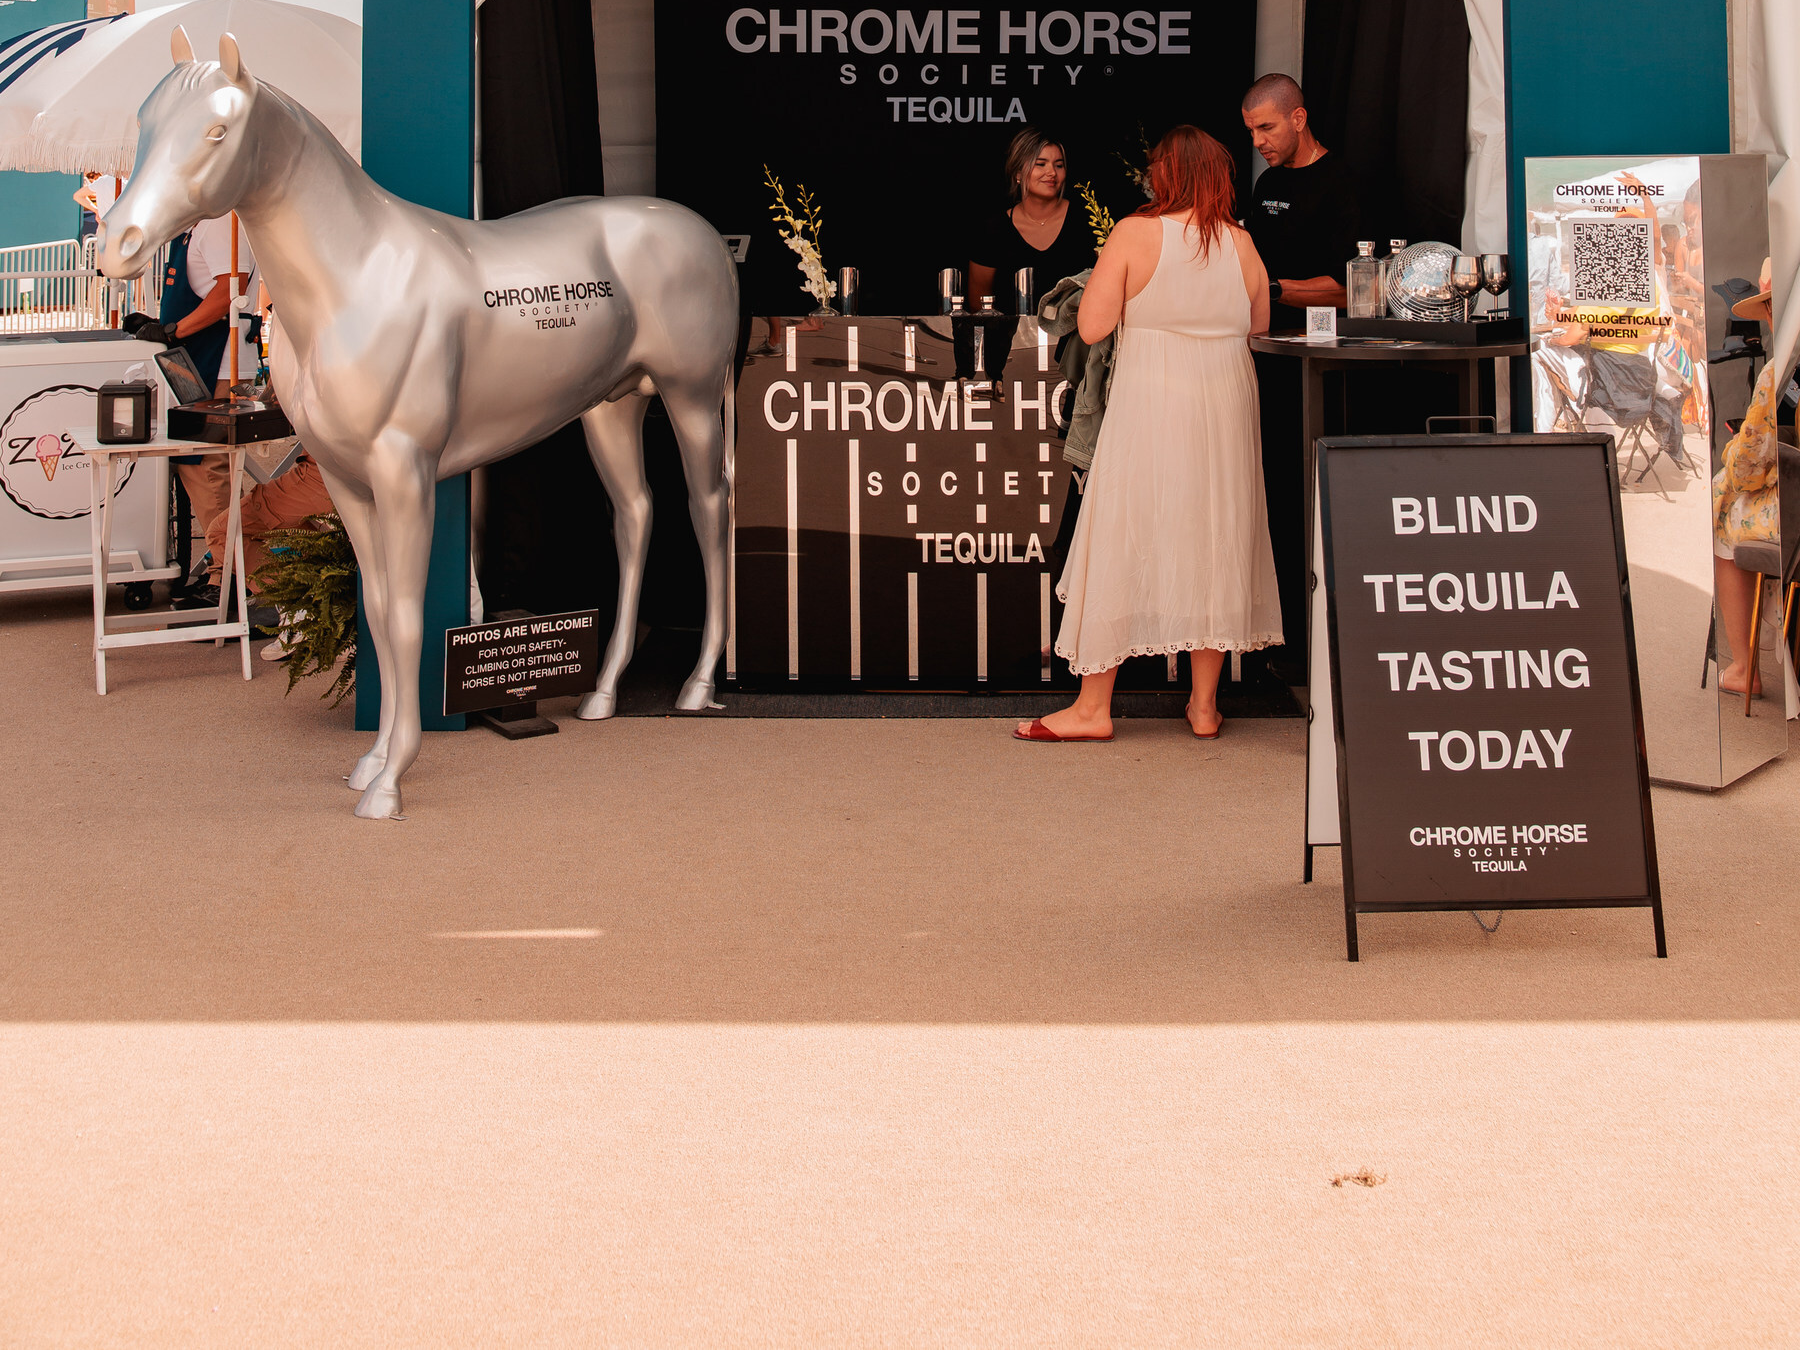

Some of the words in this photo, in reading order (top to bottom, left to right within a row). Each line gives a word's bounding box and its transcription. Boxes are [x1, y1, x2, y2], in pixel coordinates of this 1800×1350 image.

[725, 7, 981, 55] CHROME
[999, 10, 1192, 56] HORSE
[839, 63, 1083, 86] SOCIETY
[886, 96, 1027, 124] TEQUILA
[1556, 184, 1614, 196] CHROME
[1617, 184, 1665, 197] HORSE
[1593, 205, 1627, 213] TEQUILA
[484, 284, 562, 309] CHROME
[563, 281, 614, 301] HORSE
[519, 302, 590, 317] SOCIETY
[1556, 313, 1672, 326] UNAPOLOGETICALLY
[535, 316, 577, 330] TEQUILA
[1588, 327, 1639, 339] MODERN
[763, 380, 994, 432] CHROME
[62, 463, 74, 471] Ice
[866, 470, 1088, 497] SOCIETY
[1391, 494, 1538, 535] BLIND
[915, 531, 1046, 565] TEQUILA
[1362, 570, 1580, 613] TEQUILA
[452, 629, 501, 646] PHOTOS
[503, 625, 528, 639] ARE
[531, 616, 593, 635] WELCOME!
[465, 660, 509, 675] CLIMBING
[511, 657, 526, 669] OR
[527, 652, 563, 666] SITTING
[565, 650, 579, 661] ON
[478, 647, 498, 659] FOR
[500, 643, 527, 657] YOUR
[462, 676, 495, 690] HORSE
[497, 674, 506, 684] IS
[508, 671, 528, 683] NOT
[529, 664, 582, 679] PERMITTED
[1377, 647, 1591, 692] TASTING
[1407, 728, 1573, 772] TODAY
[1409, 826, 1508, 847] CHROME
[1512, 823, 1588, 844] HORSE
[1453, 846, 1548, 858] SOCIETY
[1472, 860, 1528, 873] TEQUILA
